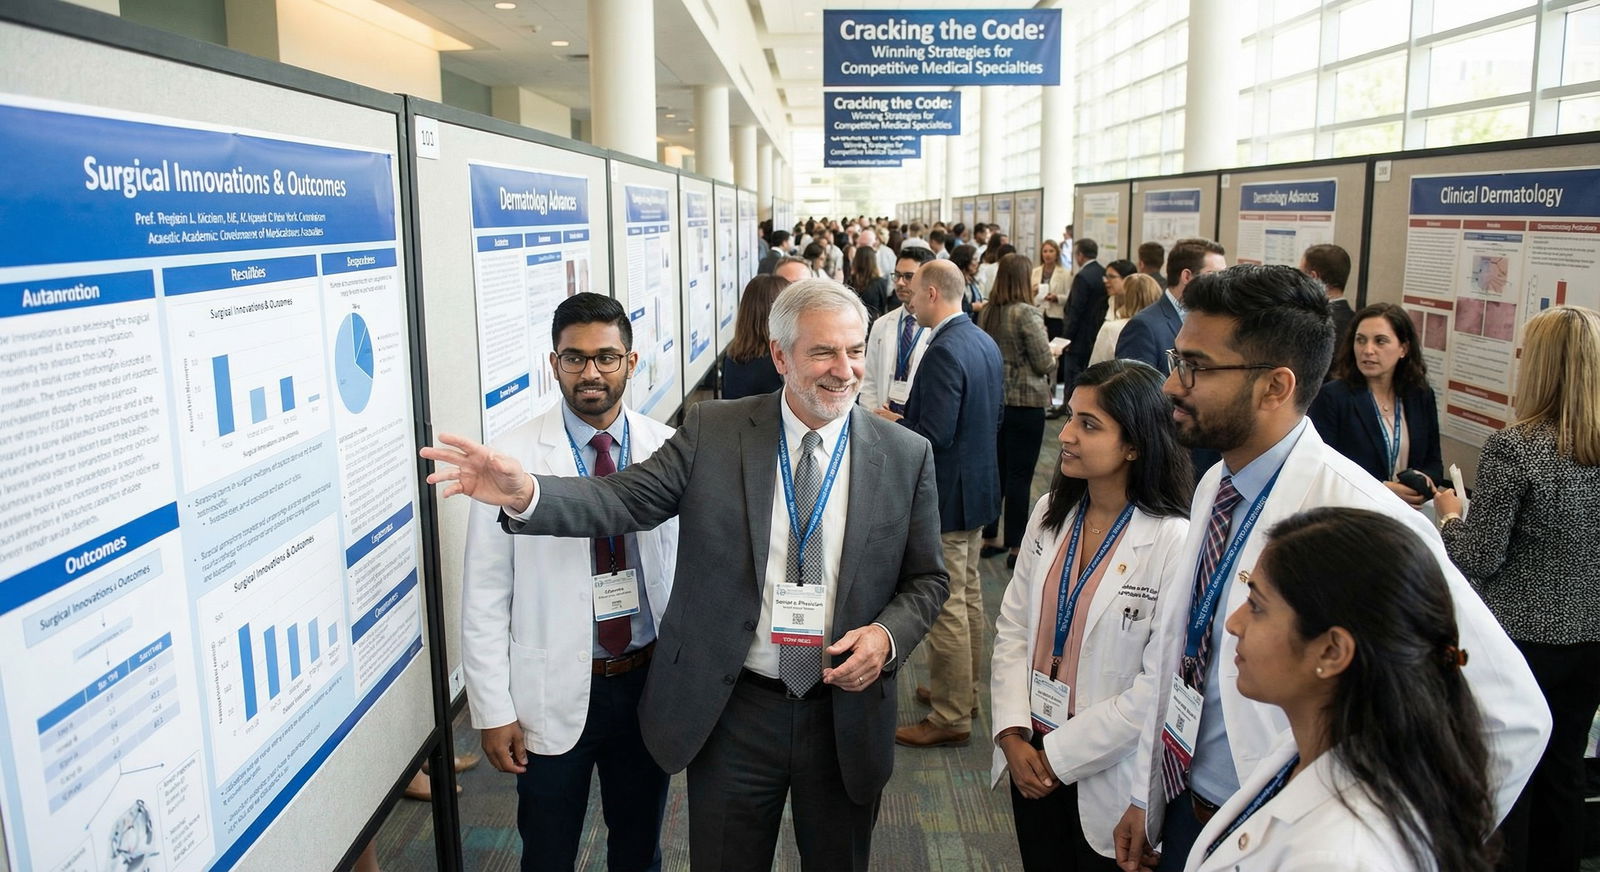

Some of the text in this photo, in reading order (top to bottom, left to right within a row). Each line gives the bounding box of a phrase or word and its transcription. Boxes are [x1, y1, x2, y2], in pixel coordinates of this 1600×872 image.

[840, 19, 1045, 44] Cracking the Code:
[872, 44, 1013, 61] Winning Strategies for
[841, 61, 1043, 77] Competitive Medical Specialties
[834, 97, 952, 112] Cracking the Code:
[851, 111, 935, 121] Winning Strategies for
[834, 121, 952, 131] Competitive Medical Specialties
[84, 156, 347, 199] Surgical Innovations & Outcomes
[499, 186, 577, 216] Dermatology Advances
[1288, 189, 1319, 204] Advances
[1440, 182, 1564, 208] Clinical Dermatology
[65, 535, 128, 575] Outcomes
[234, 570, 257, 593] Surgical
[256, 553, 286, 578] Innovations
[290, 535, 315, 555] Outcomes
[40, 608, 72, 631] Surgical
[72, 586, 114, 613] Innovations
[117, 564, 151, 588] Outcomes
